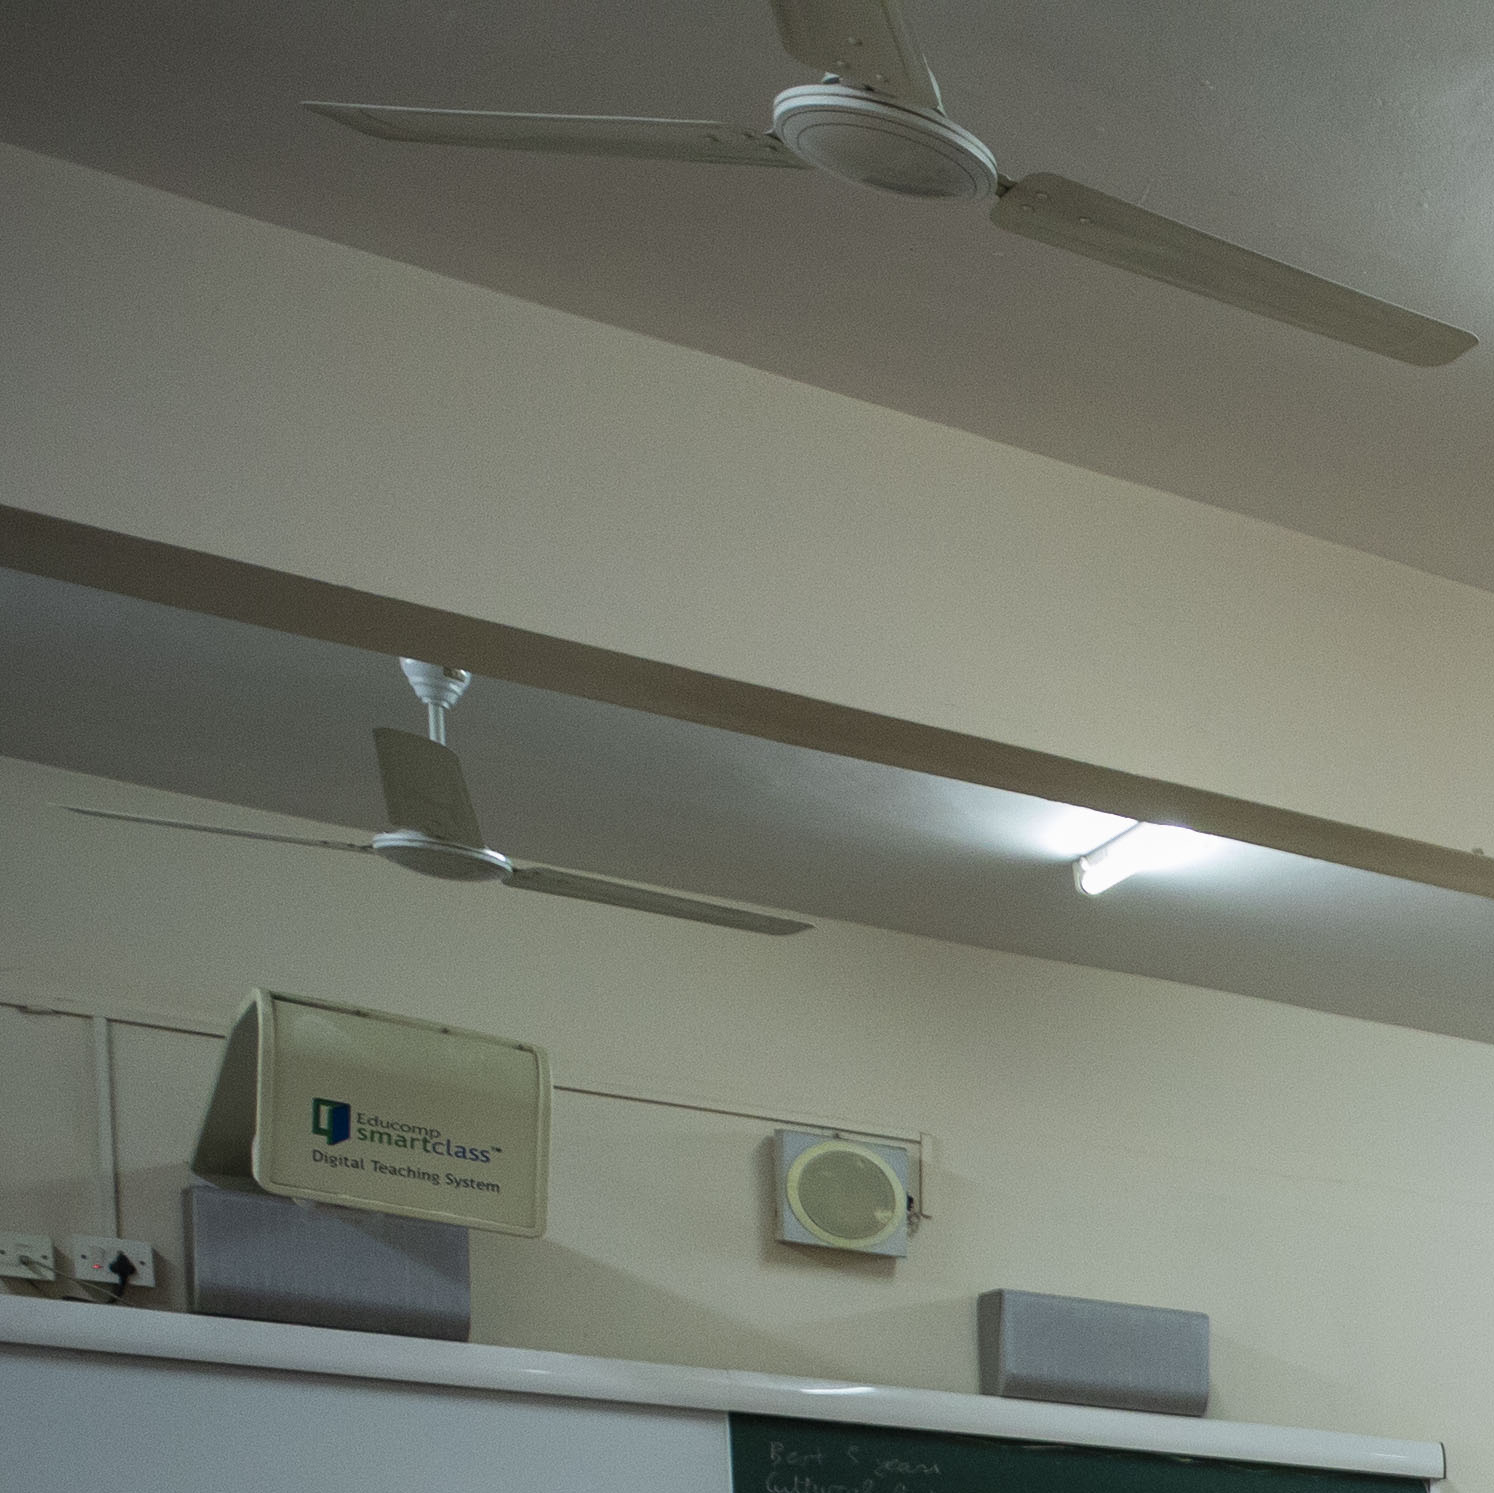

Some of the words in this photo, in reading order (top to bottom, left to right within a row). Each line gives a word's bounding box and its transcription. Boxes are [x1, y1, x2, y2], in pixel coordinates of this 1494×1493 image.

[357, 1112, 441, 1139] Educomp
[312, 1149, 365, 1170] Digital
[371, 1160, 440, 1185] Teaching
[445, 1173, 500, 1193] System
